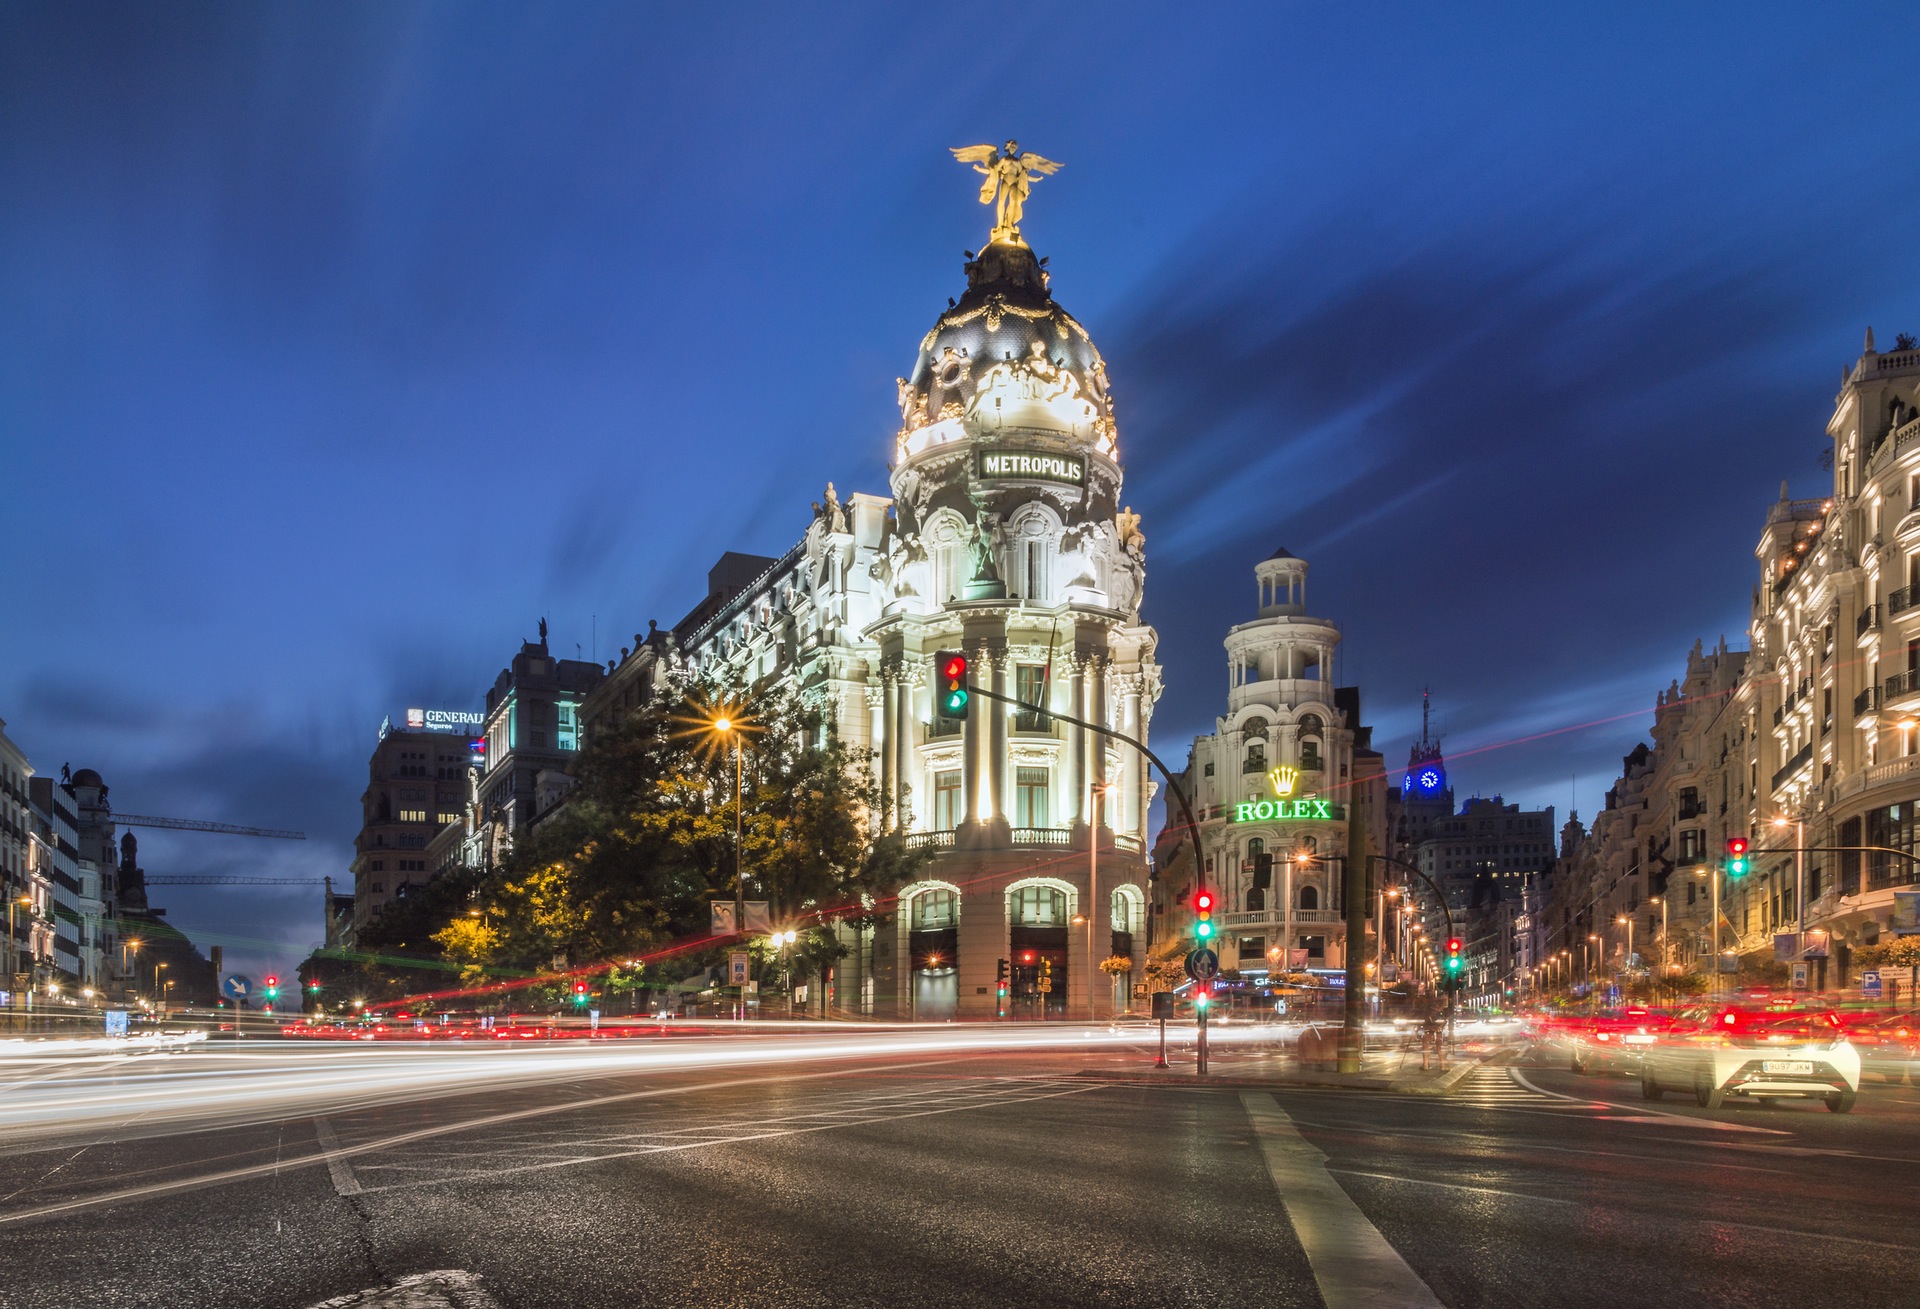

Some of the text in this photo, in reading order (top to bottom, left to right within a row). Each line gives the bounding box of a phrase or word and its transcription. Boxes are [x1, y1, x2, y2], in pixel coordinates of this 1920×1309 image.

[985, 455, 1081, 479] METROPOLIS
[426, 722, 453, 730] Seguros
[1236, 801, 1331, 821] ROLEX
[1864, 973, 1877, 988] P
